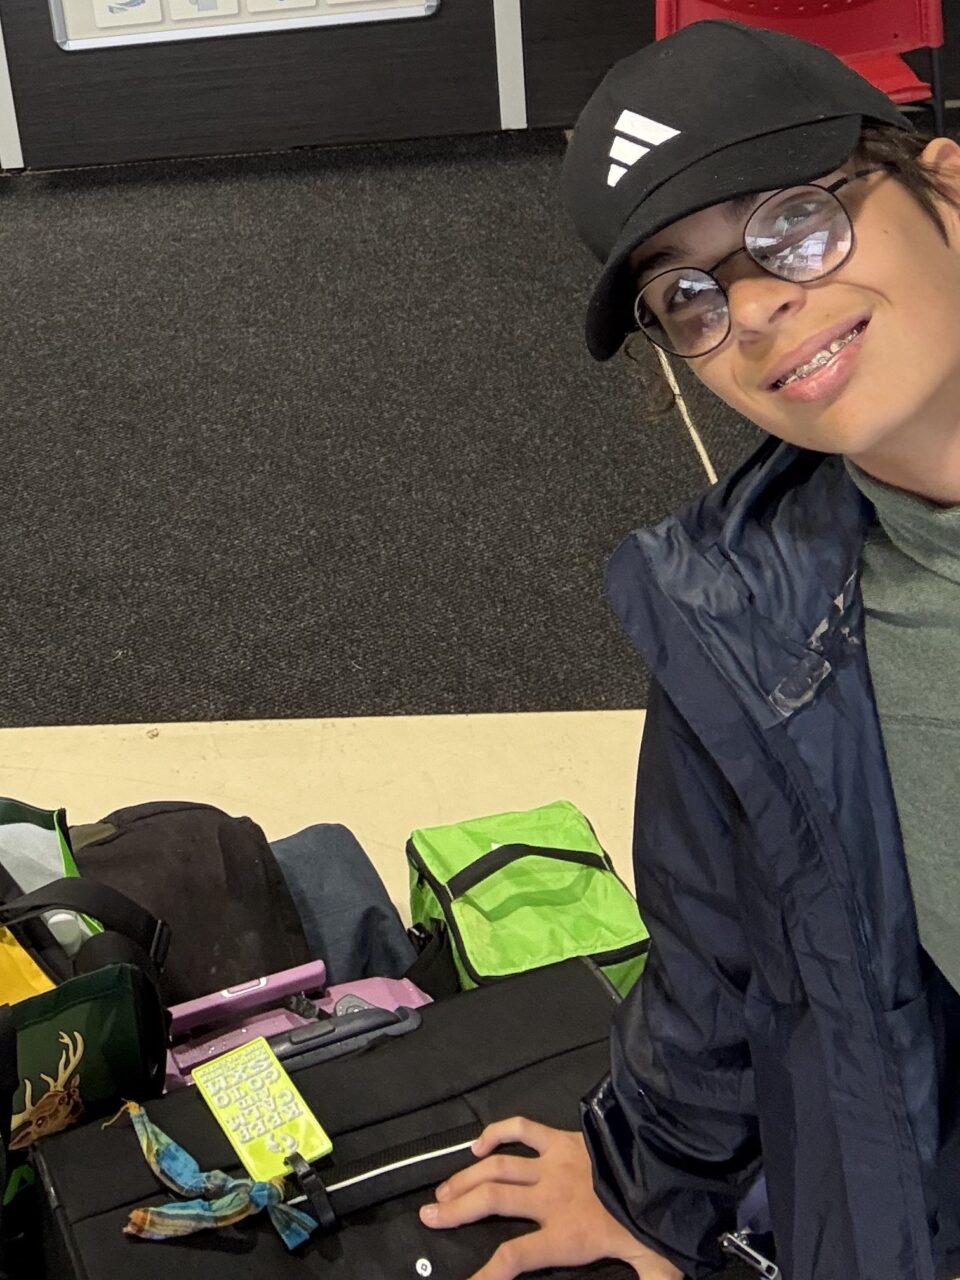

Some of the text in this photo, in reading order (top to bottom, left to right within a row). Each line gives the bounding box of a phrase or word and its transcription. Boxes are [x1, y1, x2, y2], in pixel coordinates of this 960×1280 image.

[205, 1056, 274, 1097] SXM
[214, 1069, 281, 1109] GO TO
[225, 1088, 296, 1132] CALM
[239, 1102, 303, 1145] KEEP
